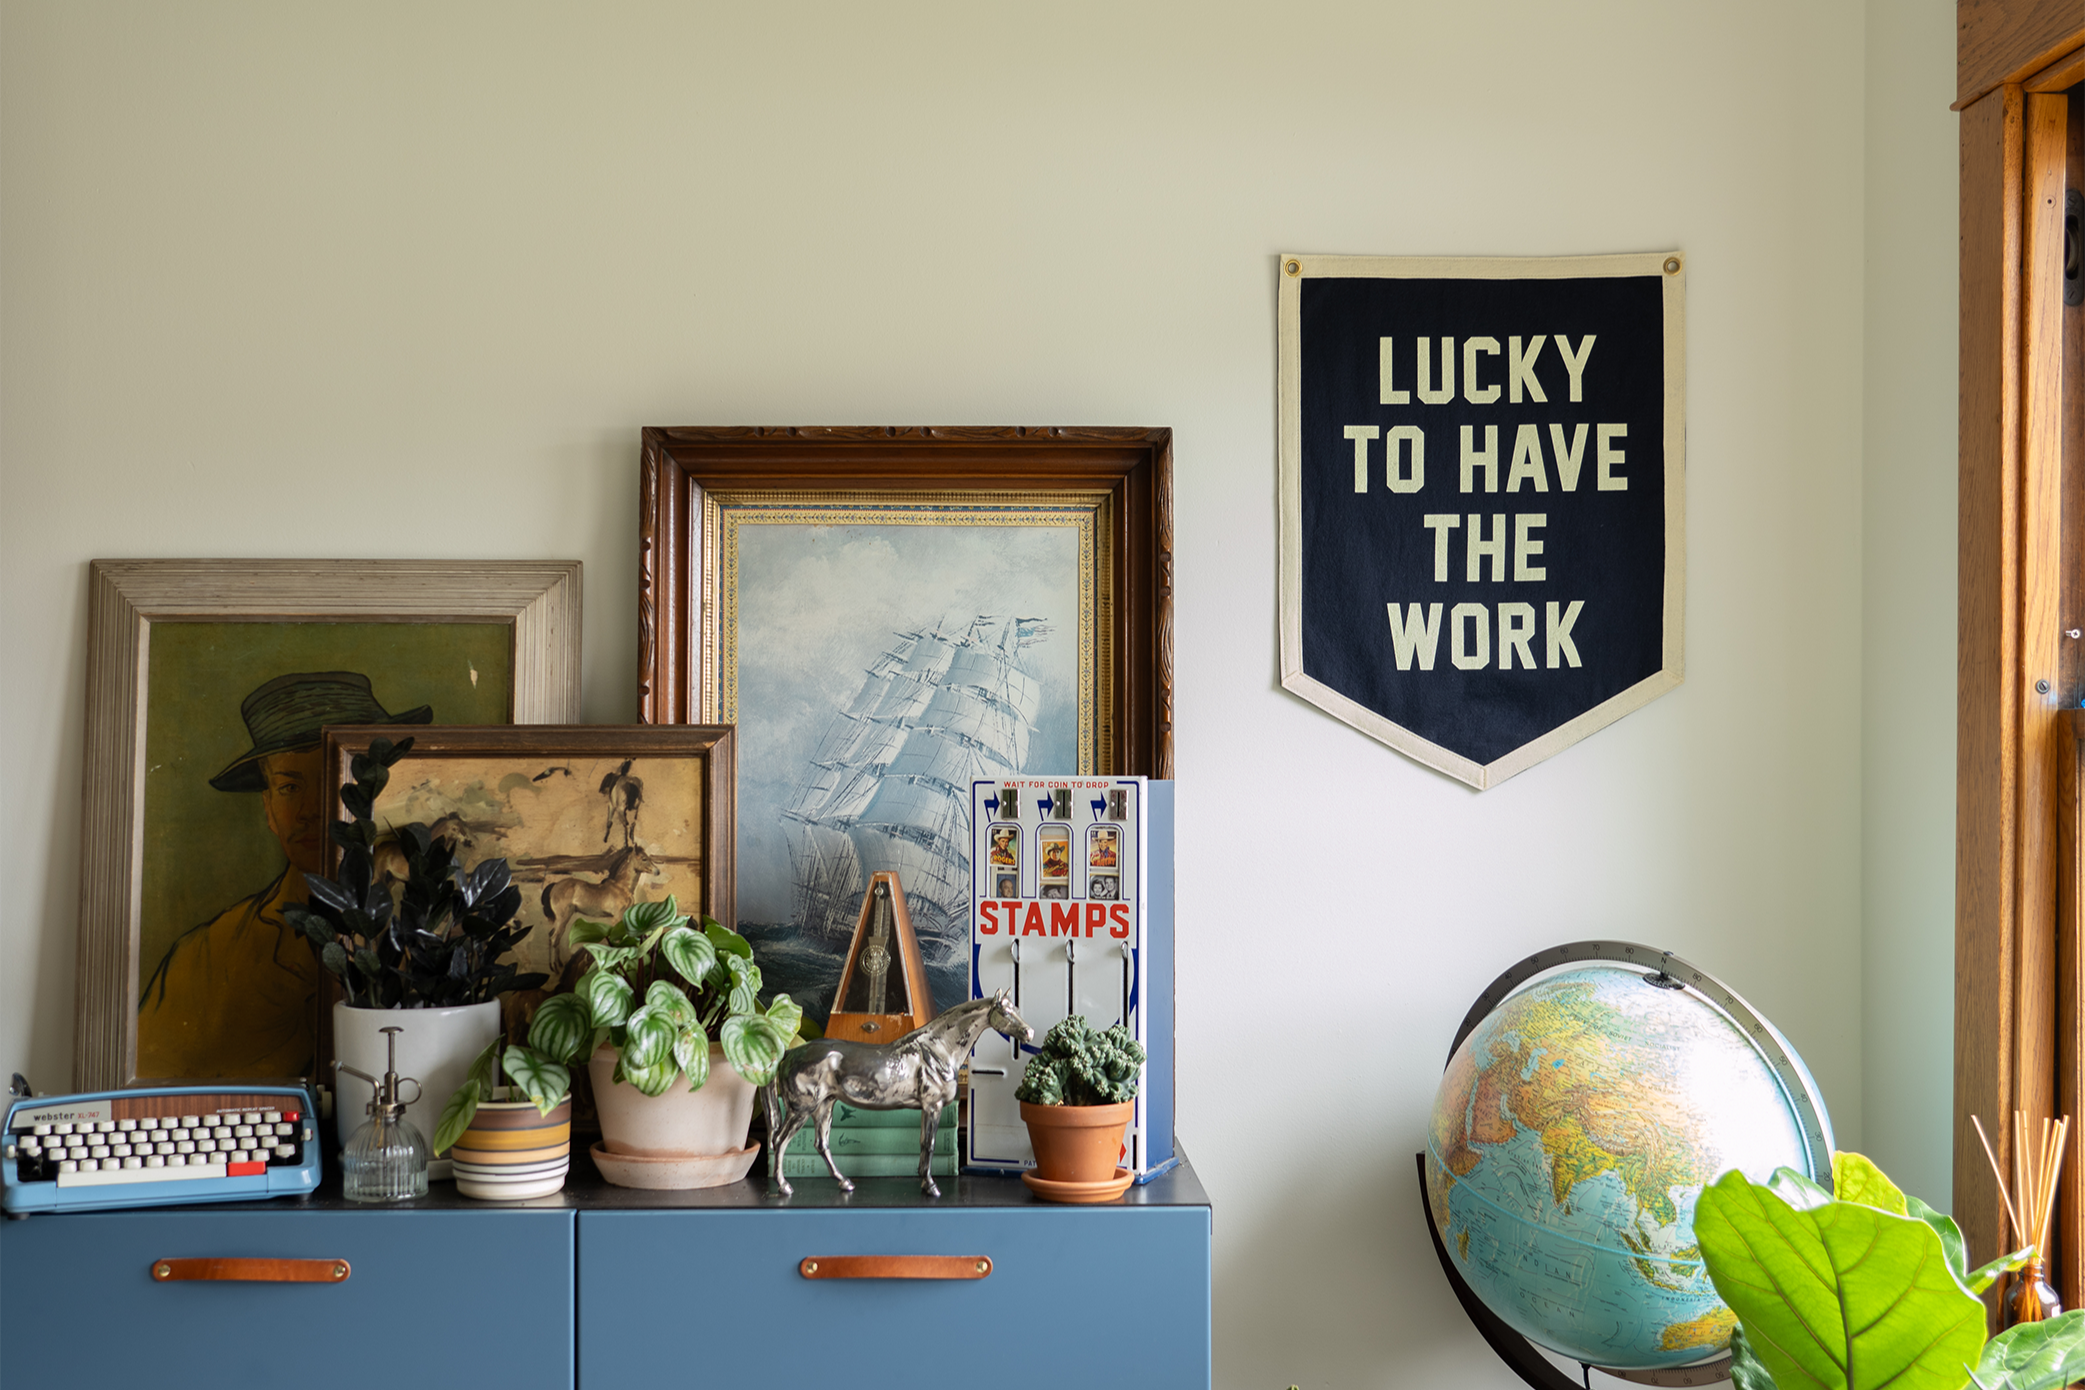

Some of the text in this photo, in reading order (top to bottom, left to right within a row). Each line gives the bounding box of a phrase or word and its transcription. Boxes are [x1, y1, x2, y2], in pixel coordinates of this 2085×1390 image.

[1380, 334, 1597, 405] LUCKY
[1343, 423, 1629, 494] TO HAVE
[1424, 513, 1547, 582] THE
[1387, 601, 1585, 671] WORK
[1003, 780, 1109, 789] WAIT FOR COIN TO DROP
[980, 900, 1130, 939] STAMPS
[1591, 944, 1601, 952] 70
[1625, 947, 1635, 955] 80
[1660, 957, 1667, 965] N
[1692, 973, 1703, 982] 80
[1724, 995, 1734, 1005] 70
[1754, 1023, 1763, 1034] 60
[1608, 1030, 1632, 1042] SOVIET
[1778, 1056, 1788, 1066] 50
[1800, 1092, 1809, 1103] 40
[33, 1111, 100, 1121] webster XL-747
[1814, 1131, 1823, 1142] 30
[1823, 1171, 1831, 1182] 20
